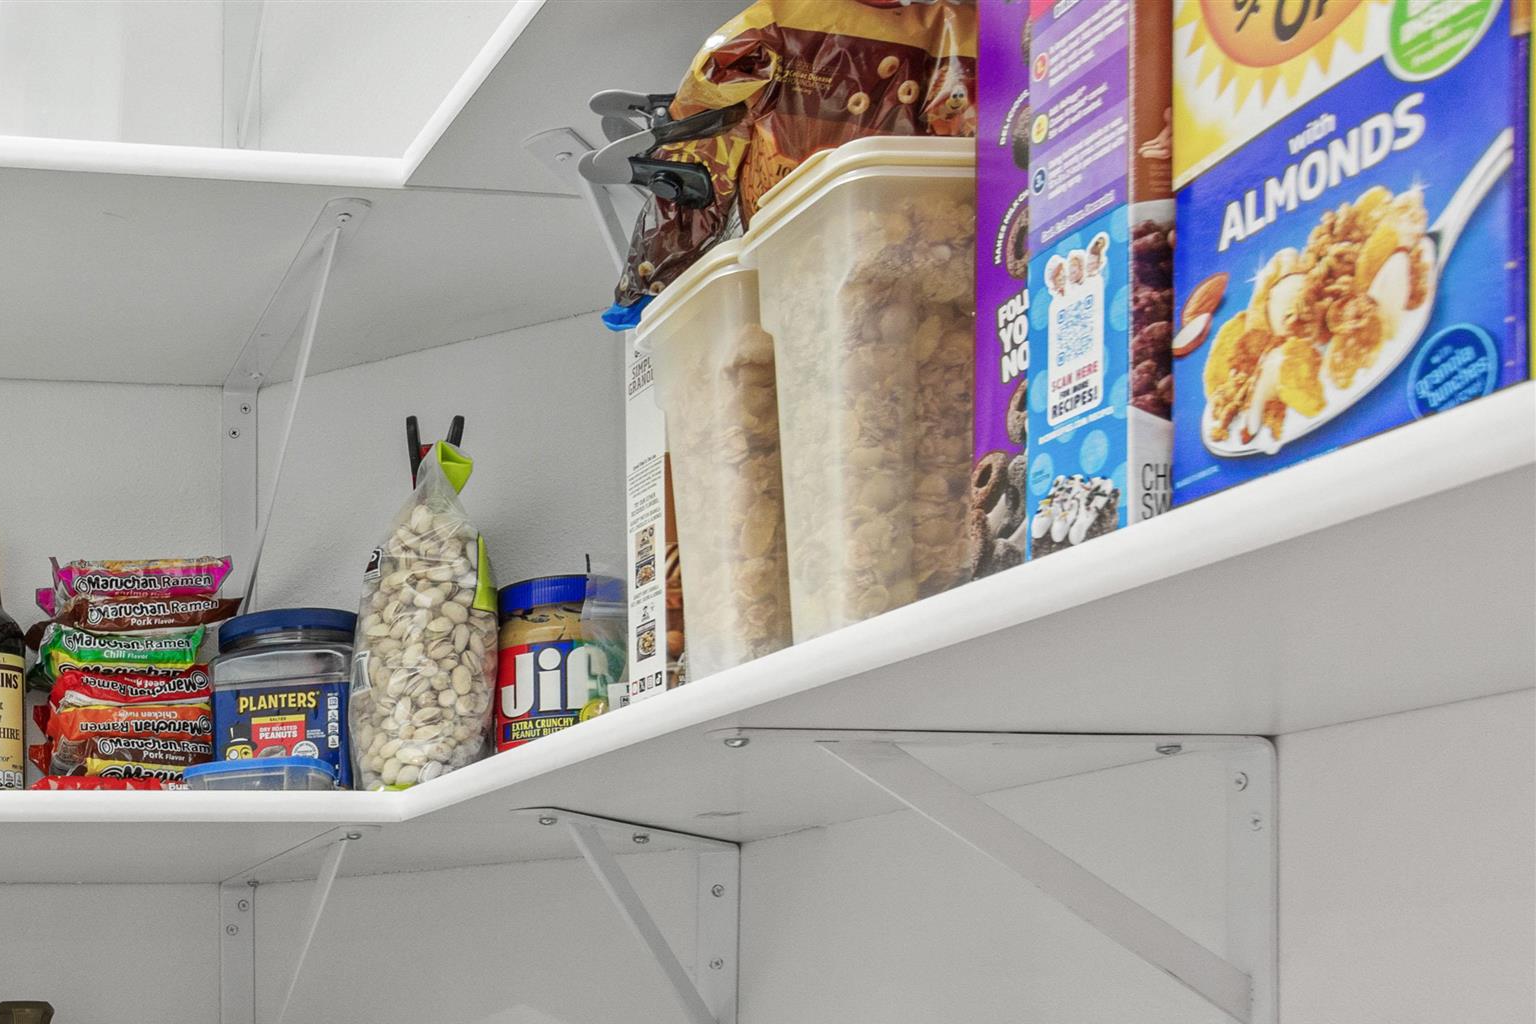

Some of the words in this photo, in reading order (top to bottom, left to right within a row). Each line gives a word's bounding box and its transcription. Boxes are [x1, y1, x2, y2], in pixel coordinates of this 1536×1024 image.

[1288, 113, 1336, 155] with
[1217, 92, 1426, 253] ALMONDS
[1051, 372, 1074, 393] SCAN
[1076, 361, 1098, 379] HERE
[1051, 385, 1098, 419] RECIPES!
[87, 575, 160, 591] Maruchan
[160, 574, 213, 588] Ramen
[100, 601, 169, 619] Maruchan
[170, 600, 219, 614] Ramen
[130, 617, 153, 627] Pork
[103, 650, 126, 659] Chili
[501, 646, 609, 718] Jif
[239, 691, 317, 714] PLANTERS
[80, 721, 129, 732] Ramen
[511, 720, 534, 732] EXTRA
[535, 717, 575, 728] CRUNCHY
[259, 731, 298, 740] PEANUTS
[511, 727, 540, 740] PEANUT
[143, 750, 164, 760] Pork
[165, 753, 185, 761] Flavor
